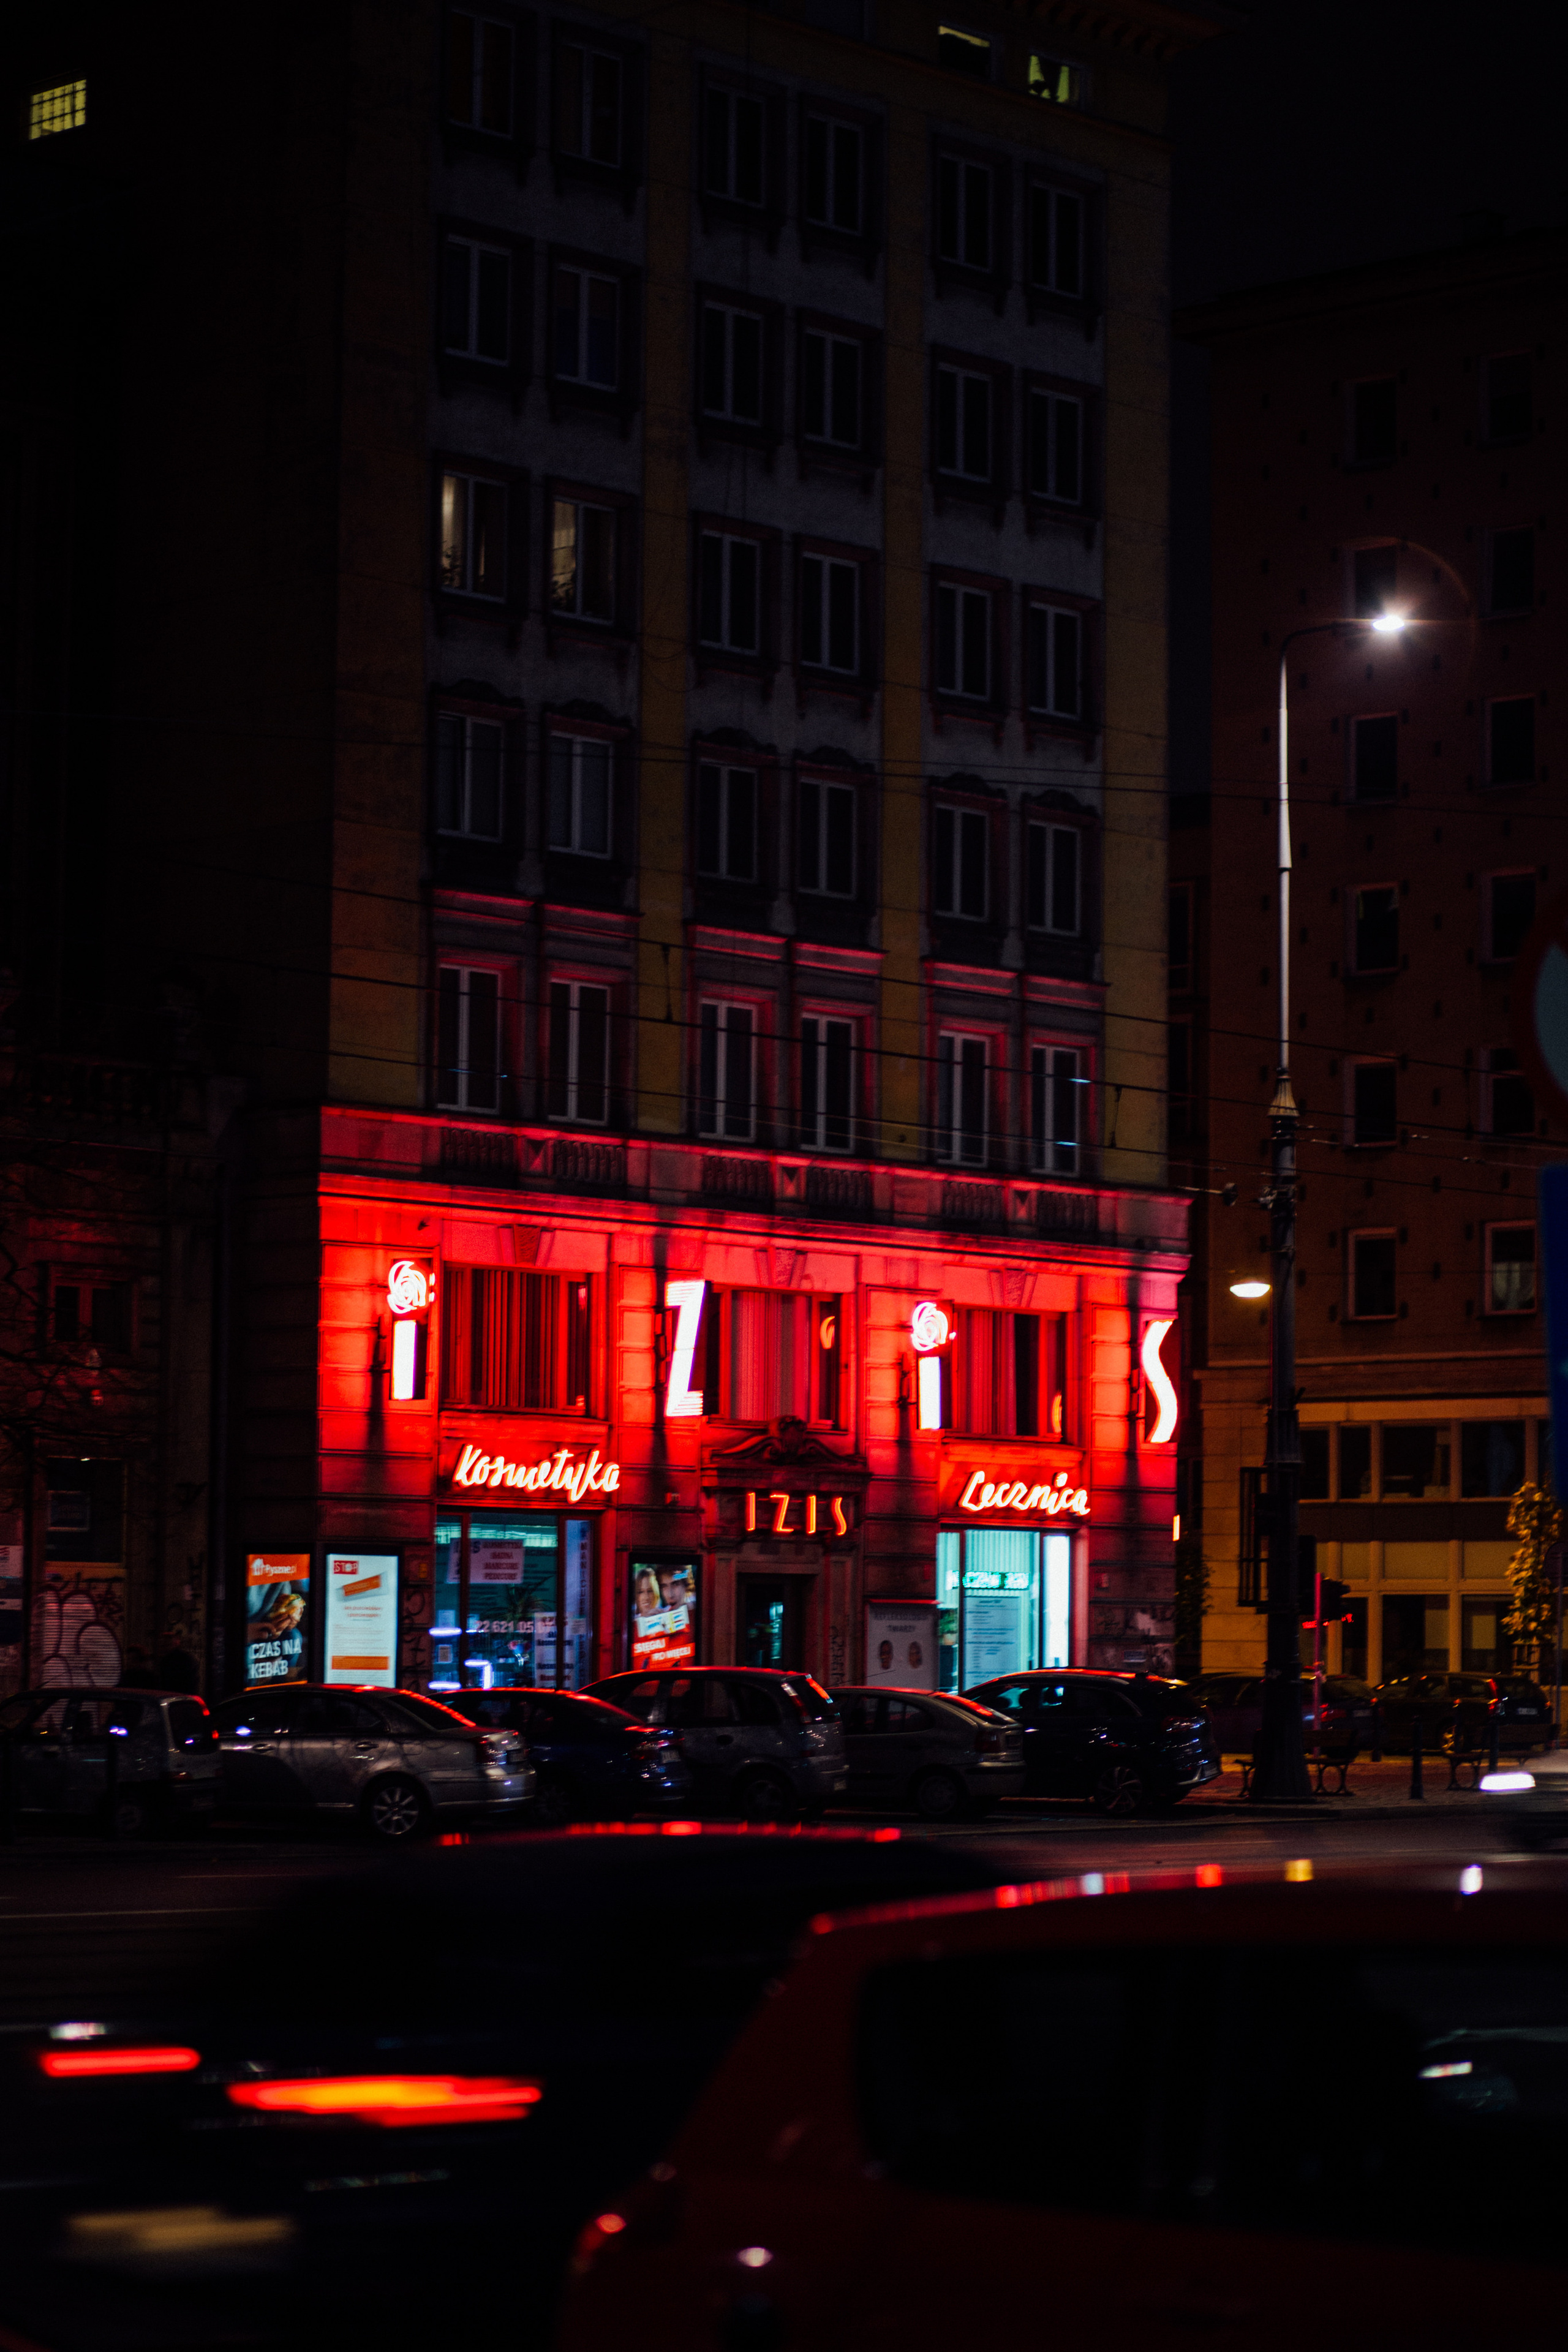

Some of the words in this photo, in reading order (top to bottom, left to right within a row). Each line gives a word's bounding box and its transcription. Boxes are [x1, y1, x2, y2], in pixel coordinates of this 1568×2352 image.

[454, 1444, 620, 1503] Kosmetyka
[959, 1471, 1091, 1516] Lecznica
[746, 1491, 847, 1536] IZIS
[334, 1561, 358, 1573] STOP
[476, 1620, 489, 1633] 22
[492, 1621, 514, 1633] 621
[250, 1640, 281, 1659] CZAS
[282, 1638, 302, 1655] NA
[249, 1659, 289, 1678] KEBAB
